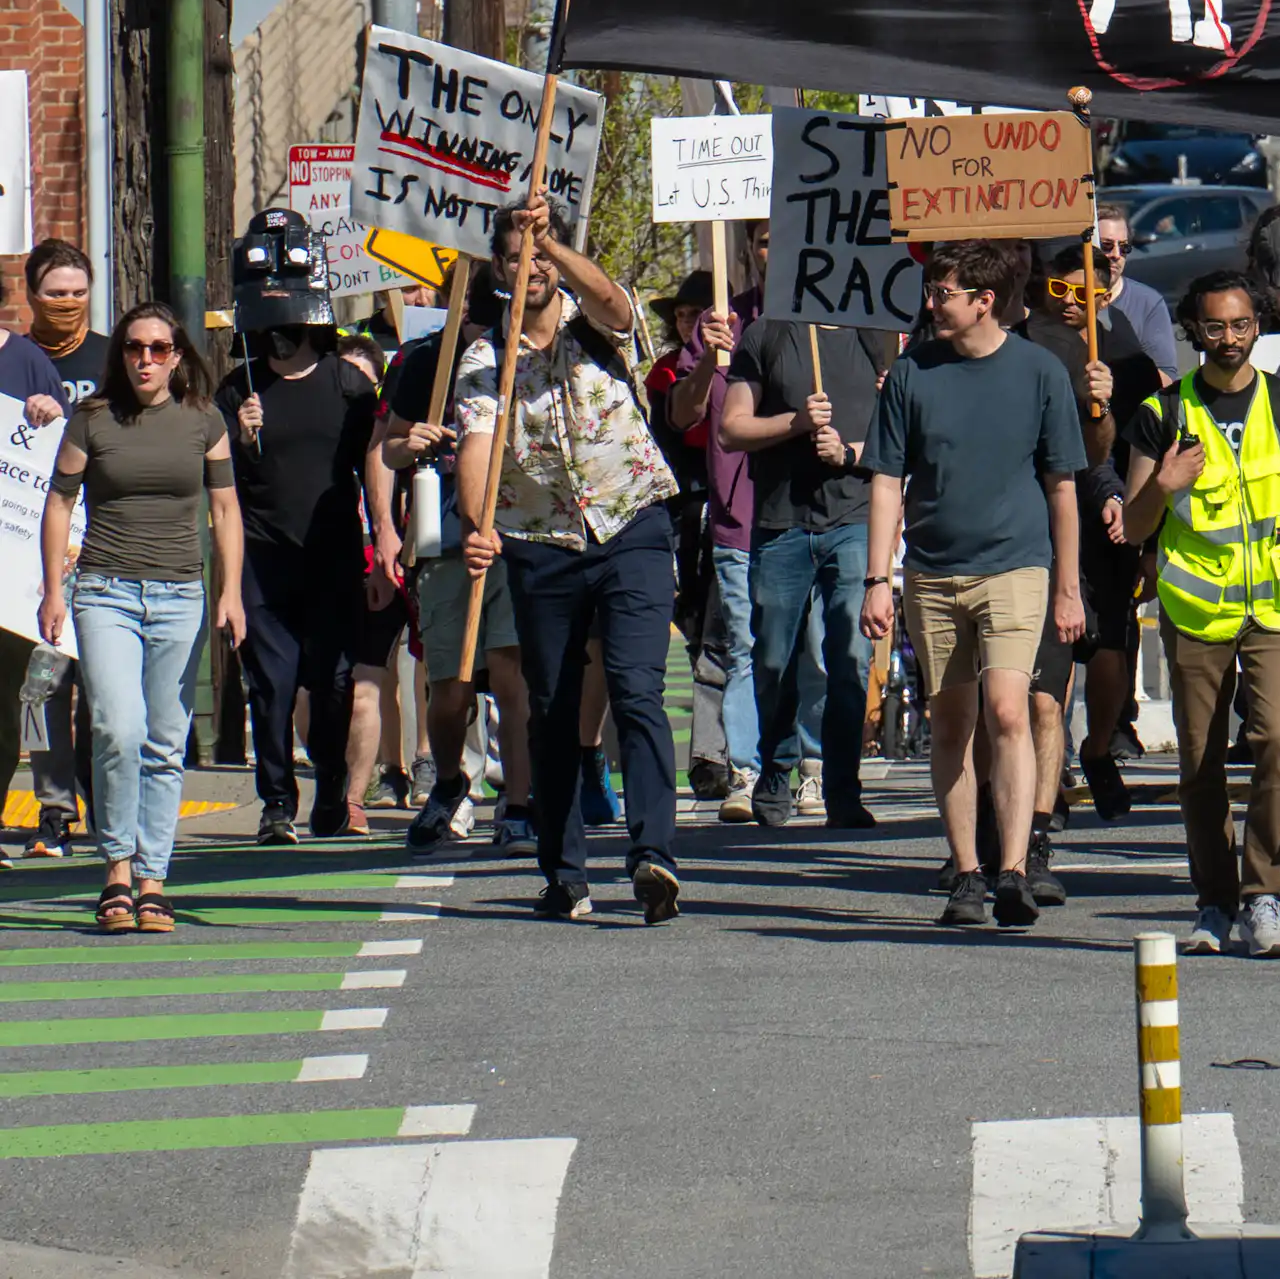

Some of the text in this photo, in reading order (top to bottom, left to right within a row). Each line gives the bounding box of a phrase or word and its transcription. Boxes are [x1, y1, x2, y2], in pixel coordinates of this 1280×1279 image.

[378, 42, 488, 117] THE
[374, 98, 522, 172] WINNING
[673, 133, 764, 163] TIME OUT
[799, 115, 888, 185] ST
[899, 118, 1062, 160] NO UNDO
[297, 148, 353, 160] TOW-AWAY
[952, 156, 994, 177] FOR
[290, 160, 352, 183] NO STOPPIN
[309, 193, 342, 210] ANY
[365, 166, 419, 205] IS
[423, 185, 475, 228] NOT
[658, 182, 680, 208] Let
[691, 178, 738, 210] U.S.
[902, 177, 1081, 221] EXTINCTION
[785, 187, 892, 246] THE
[791, 247, 916, 323] RAC
[62, 380, 96, 405] OP
[10, 423, 35, 451] &
[2, 498, 29, 516] going
[30, 509, 41, 520] to
[4, 520, 35, 540] safety
